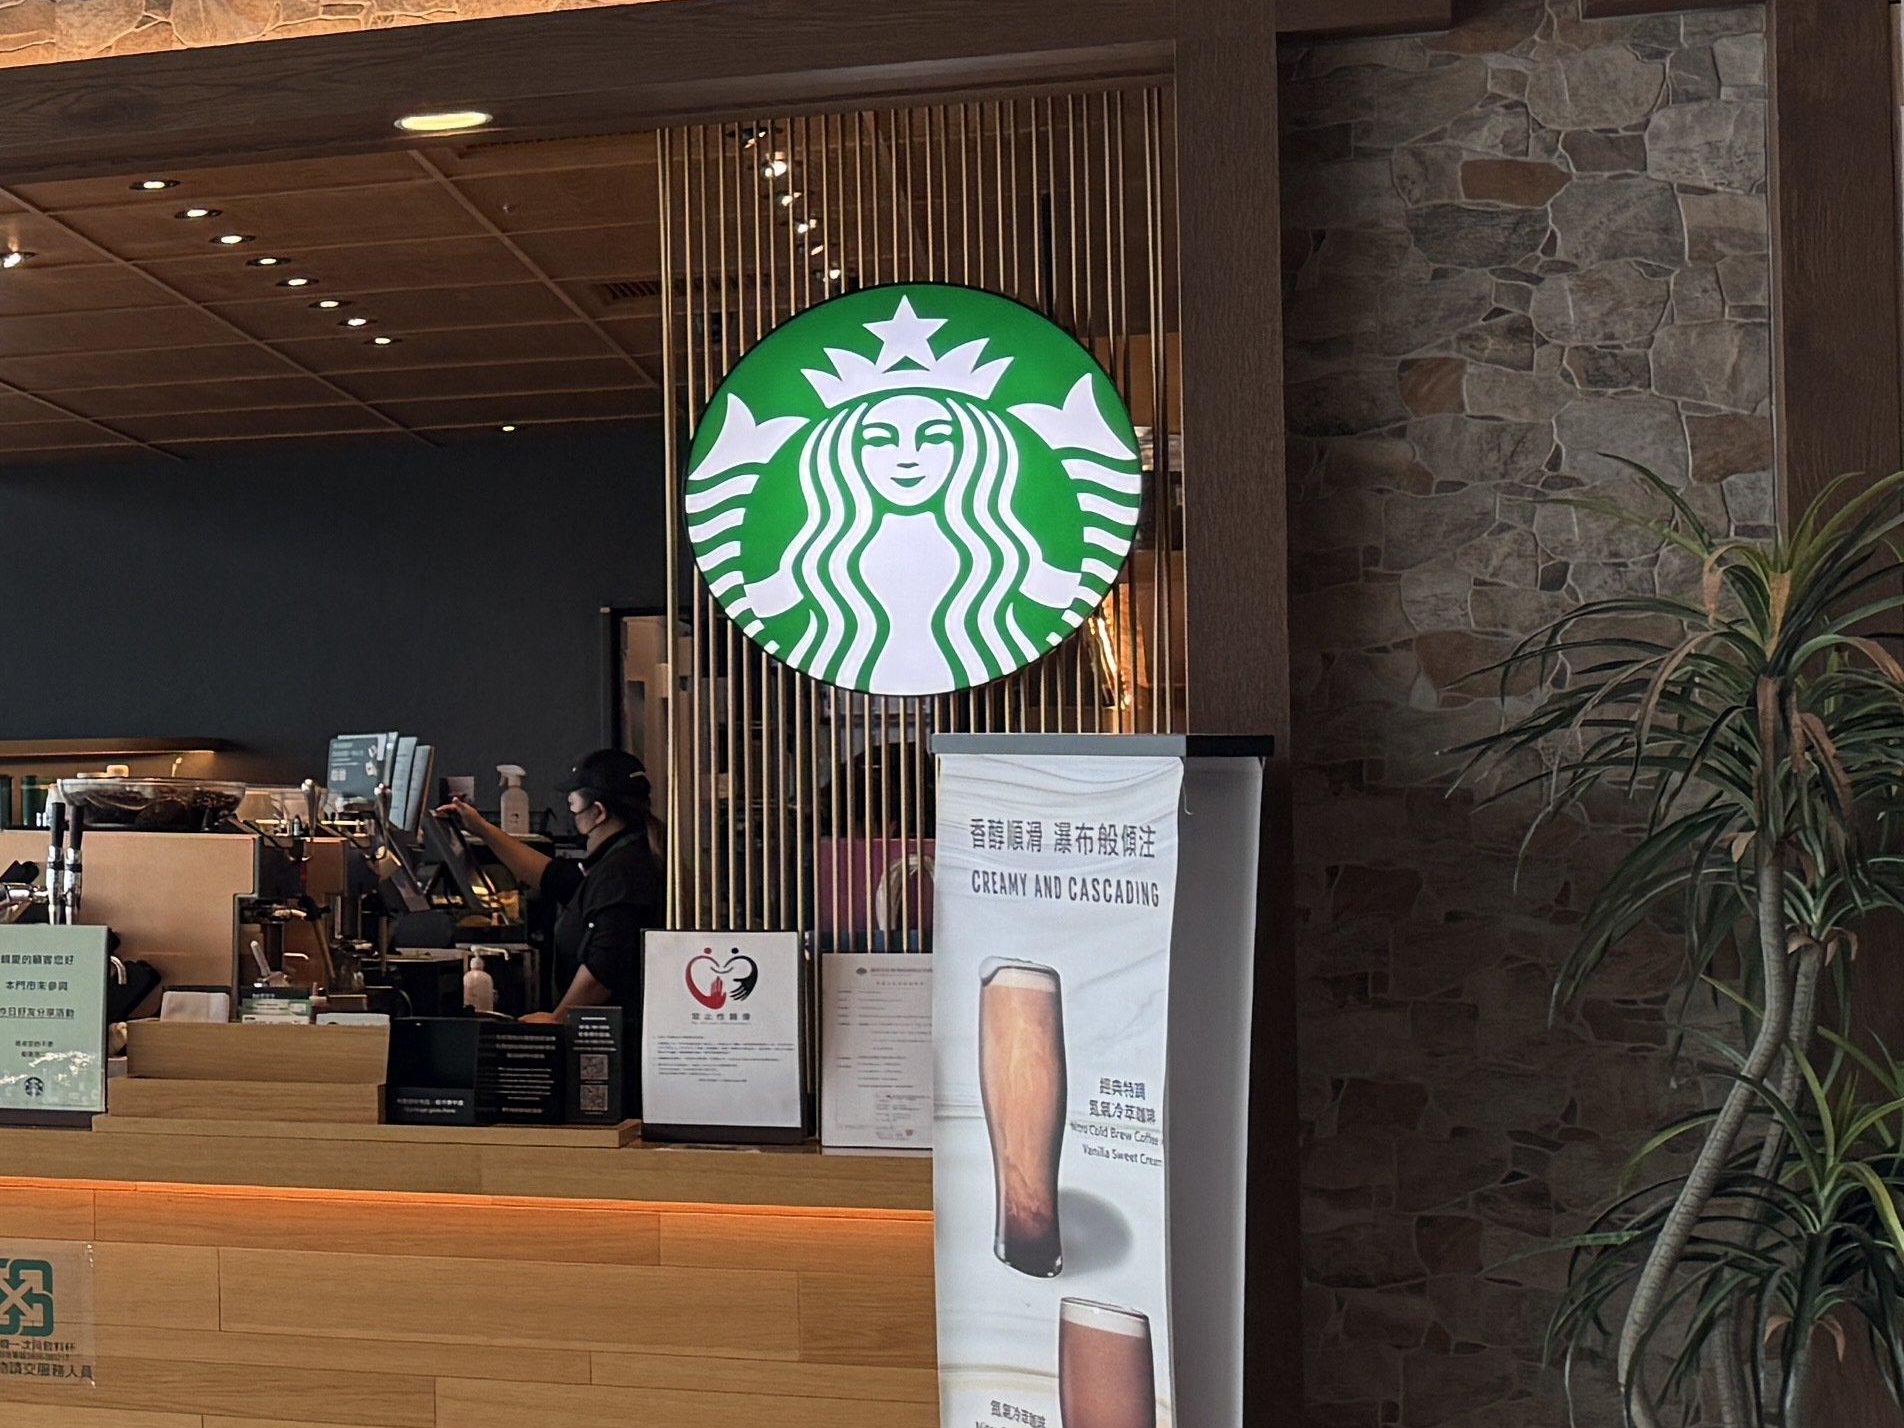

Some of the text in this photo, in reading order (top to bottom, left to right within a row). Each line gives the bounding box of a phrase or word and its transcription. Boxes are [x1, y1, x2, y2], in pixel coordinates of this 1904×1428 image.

[971, 869, 1160, 908] CREAMY AND CASCADING
[1089, 1124, 1108, 1138] Cold
[1110, 1127, 1132, 1141] Brew
[1112, 1148, 1138, 1164] Sweet
